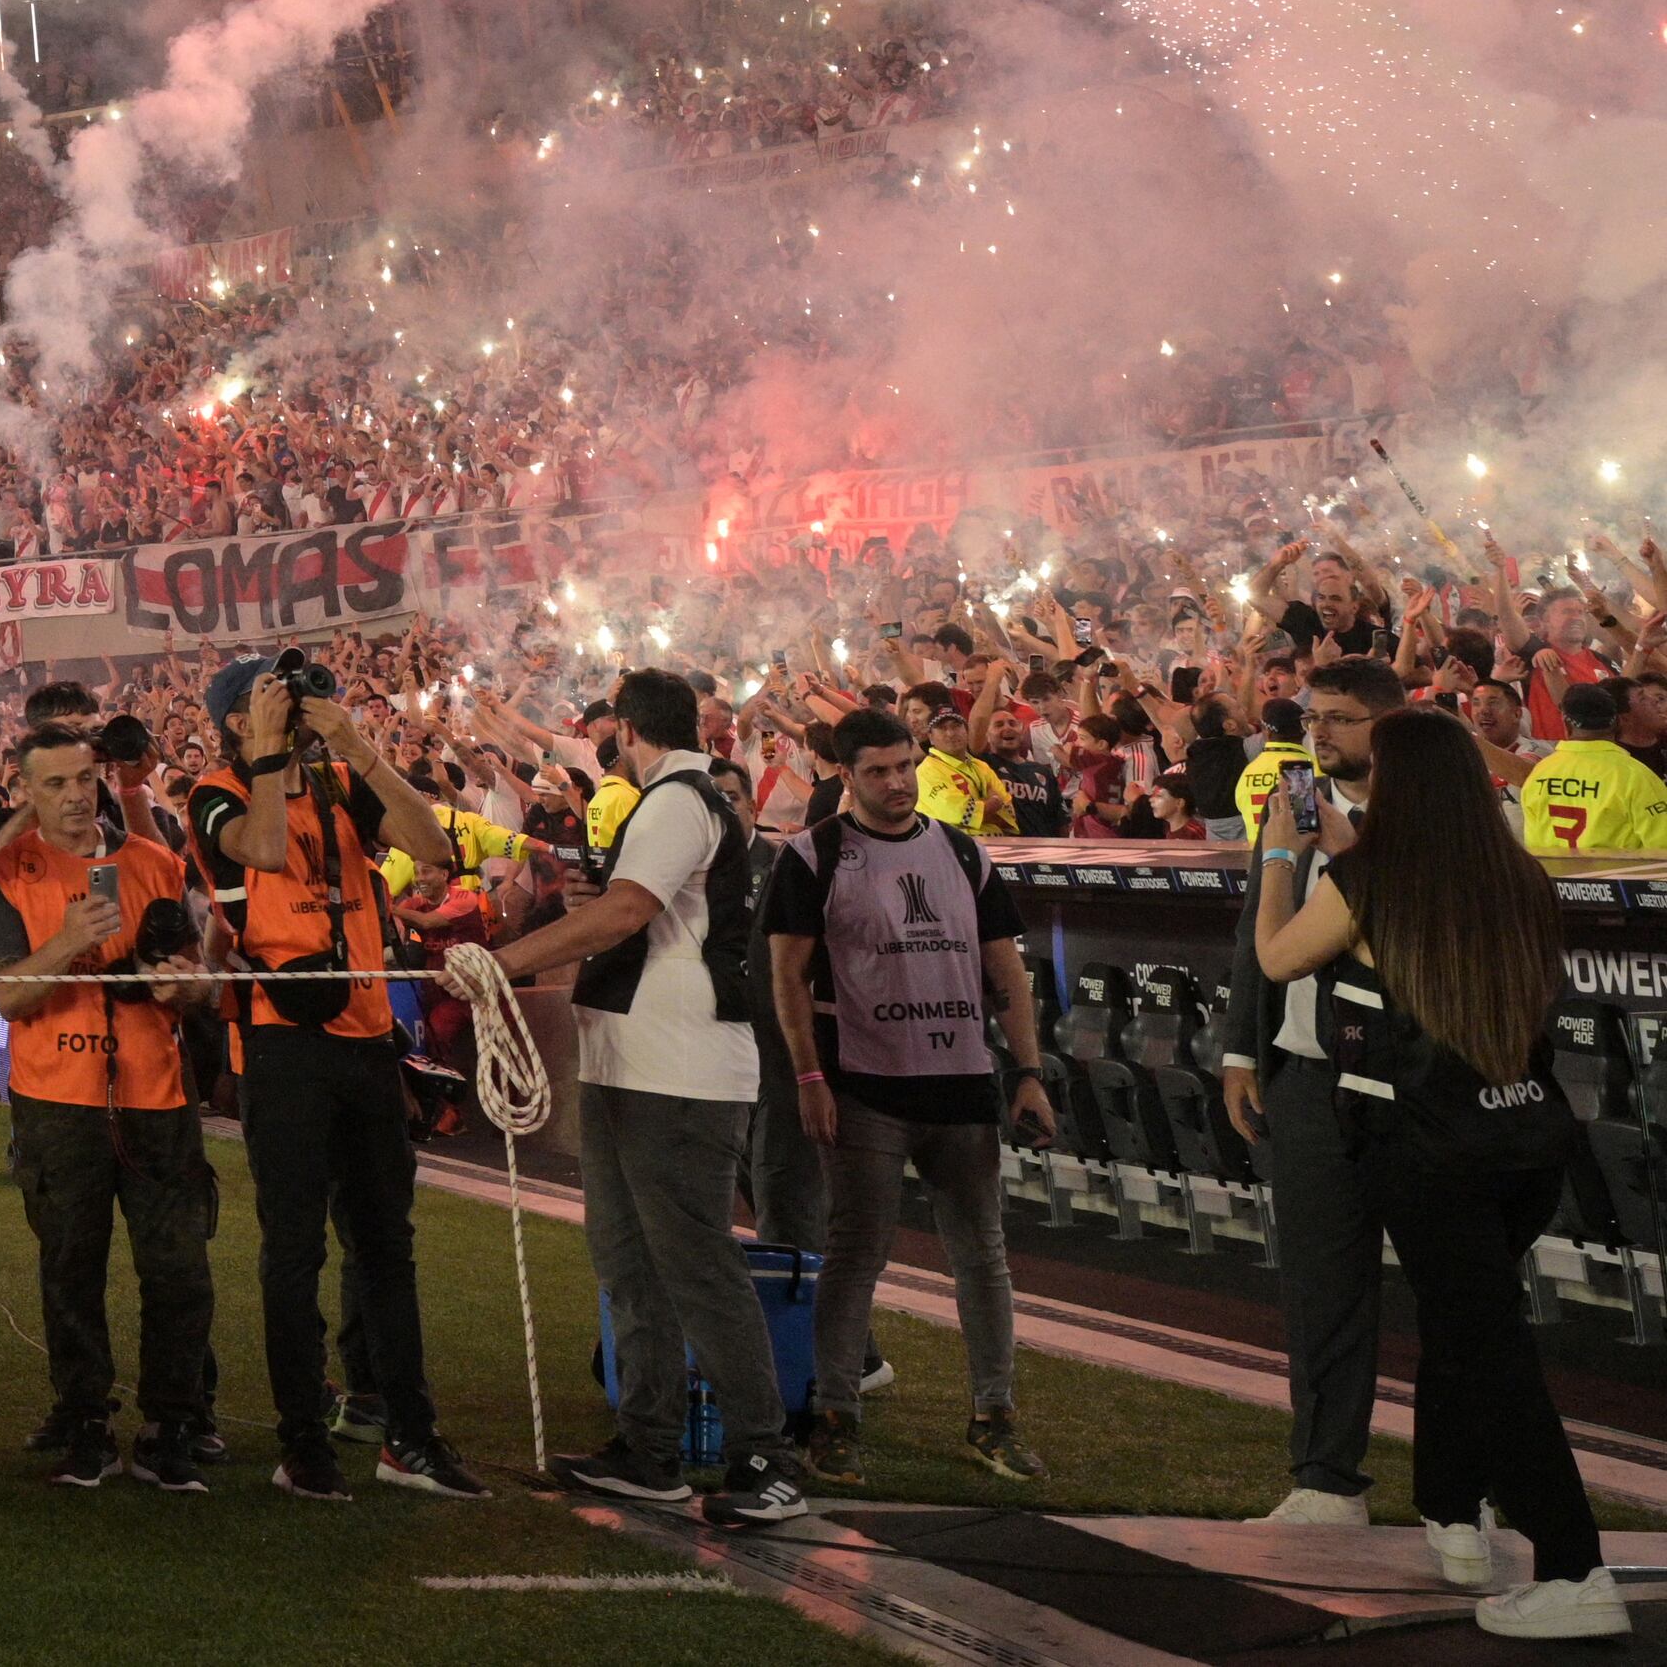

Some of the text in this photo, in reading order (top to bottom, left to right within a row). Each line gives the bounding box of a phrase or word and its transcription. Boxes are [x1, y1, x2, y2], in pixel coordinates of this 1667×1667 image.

[125, 521, 406, 635] LOMAS
[1536, 777, 1600, 799] TECH
[1076, 869, 1117, 885] POWERADE
[1179, 871, 1223, 888] POWERADE
[1557, 882, 1614, 902] POWERADE
[1079, 976, 1105, 990] POWER
[1145, 981, 1172, 996] POWER
[1215, 985, 1231, 999] POW
[1089, 989, 1104, 1002] ADE
[1156, 995, 1172, 1007] ADE
[1557, 1015, 1595, 1033] POWER
[57, 1033, 119, 1055] FOTO
[927, 1031, 955, 1050] TV
[1573, 1031, 1595, 1046] ADE
[1478, 1079, 1545, 1111] CAMPO
